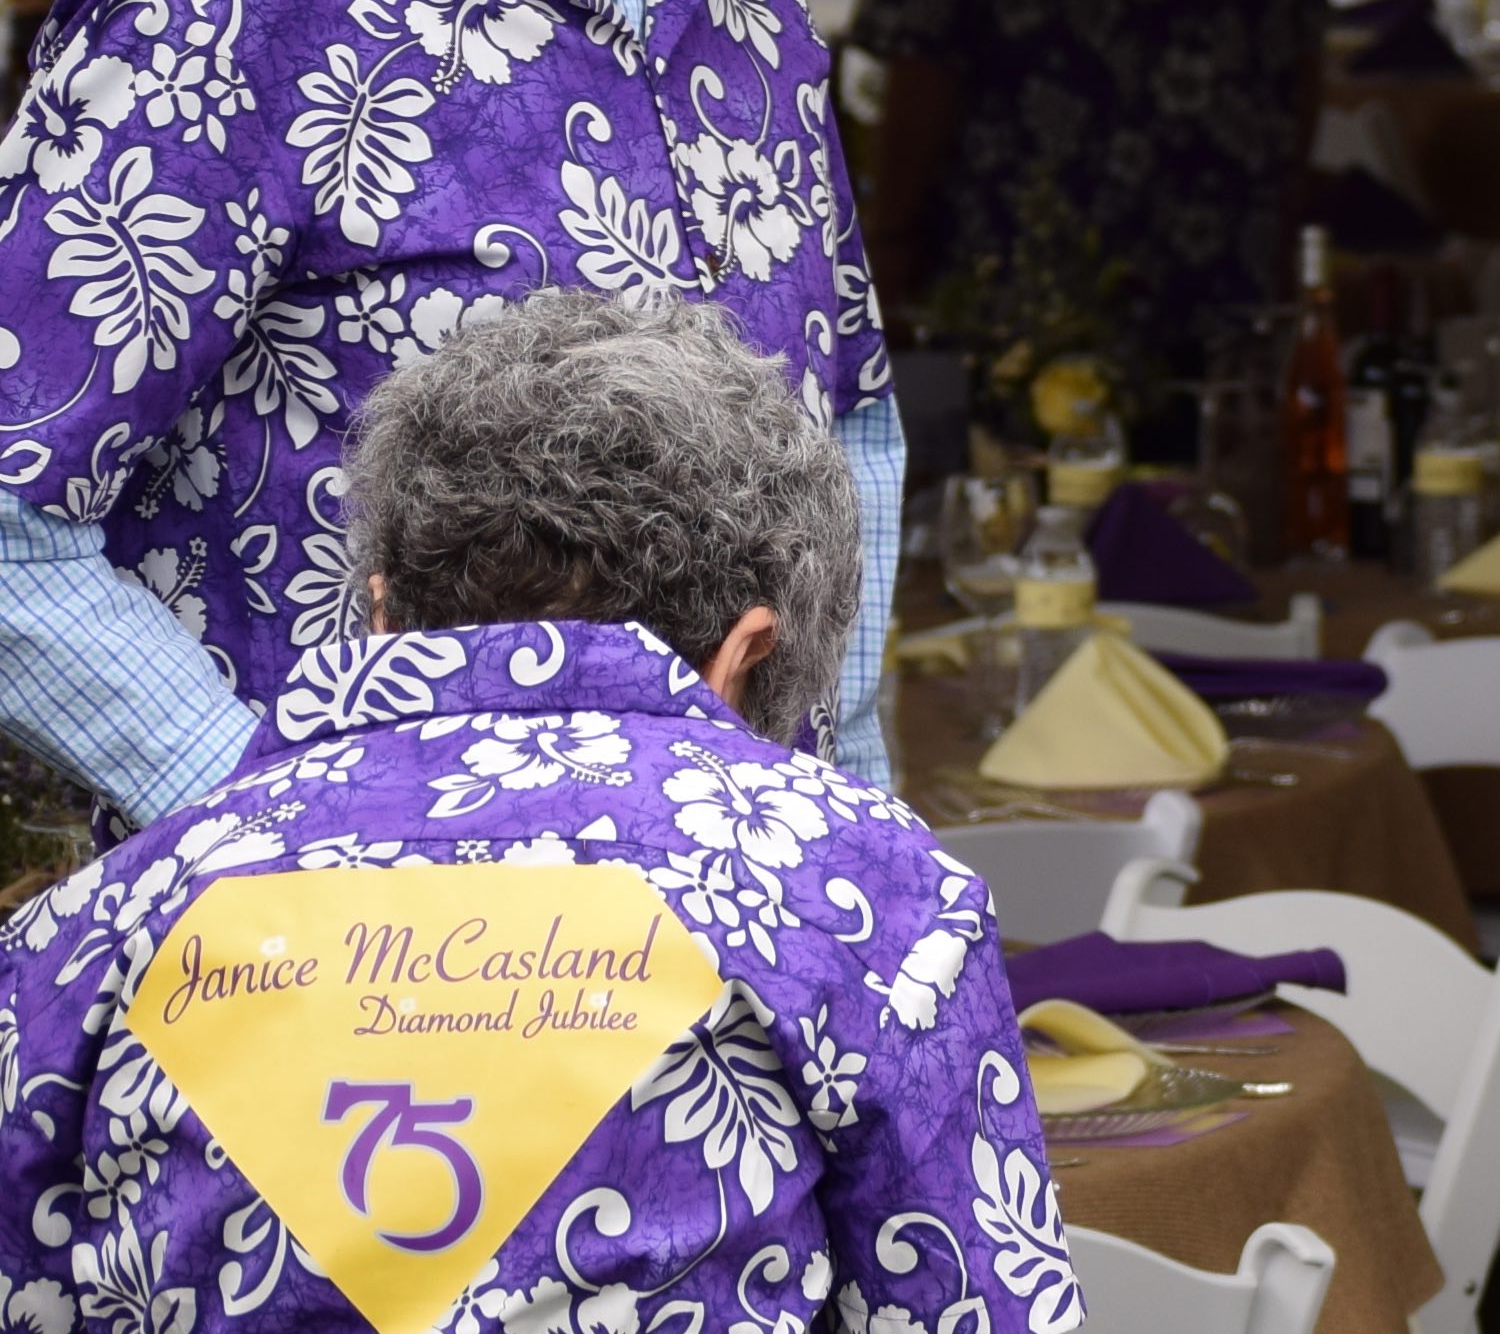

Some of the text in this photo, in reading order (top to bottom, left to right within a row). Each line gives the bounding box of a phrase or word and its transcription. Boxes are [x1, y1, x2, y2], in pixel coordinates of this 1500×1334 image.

[163, 914, 662, 1024] Janice McCasland
[353, 989, 638, 1039] Diamond Jubilee
[321, 1079, 486, 1254] 75
